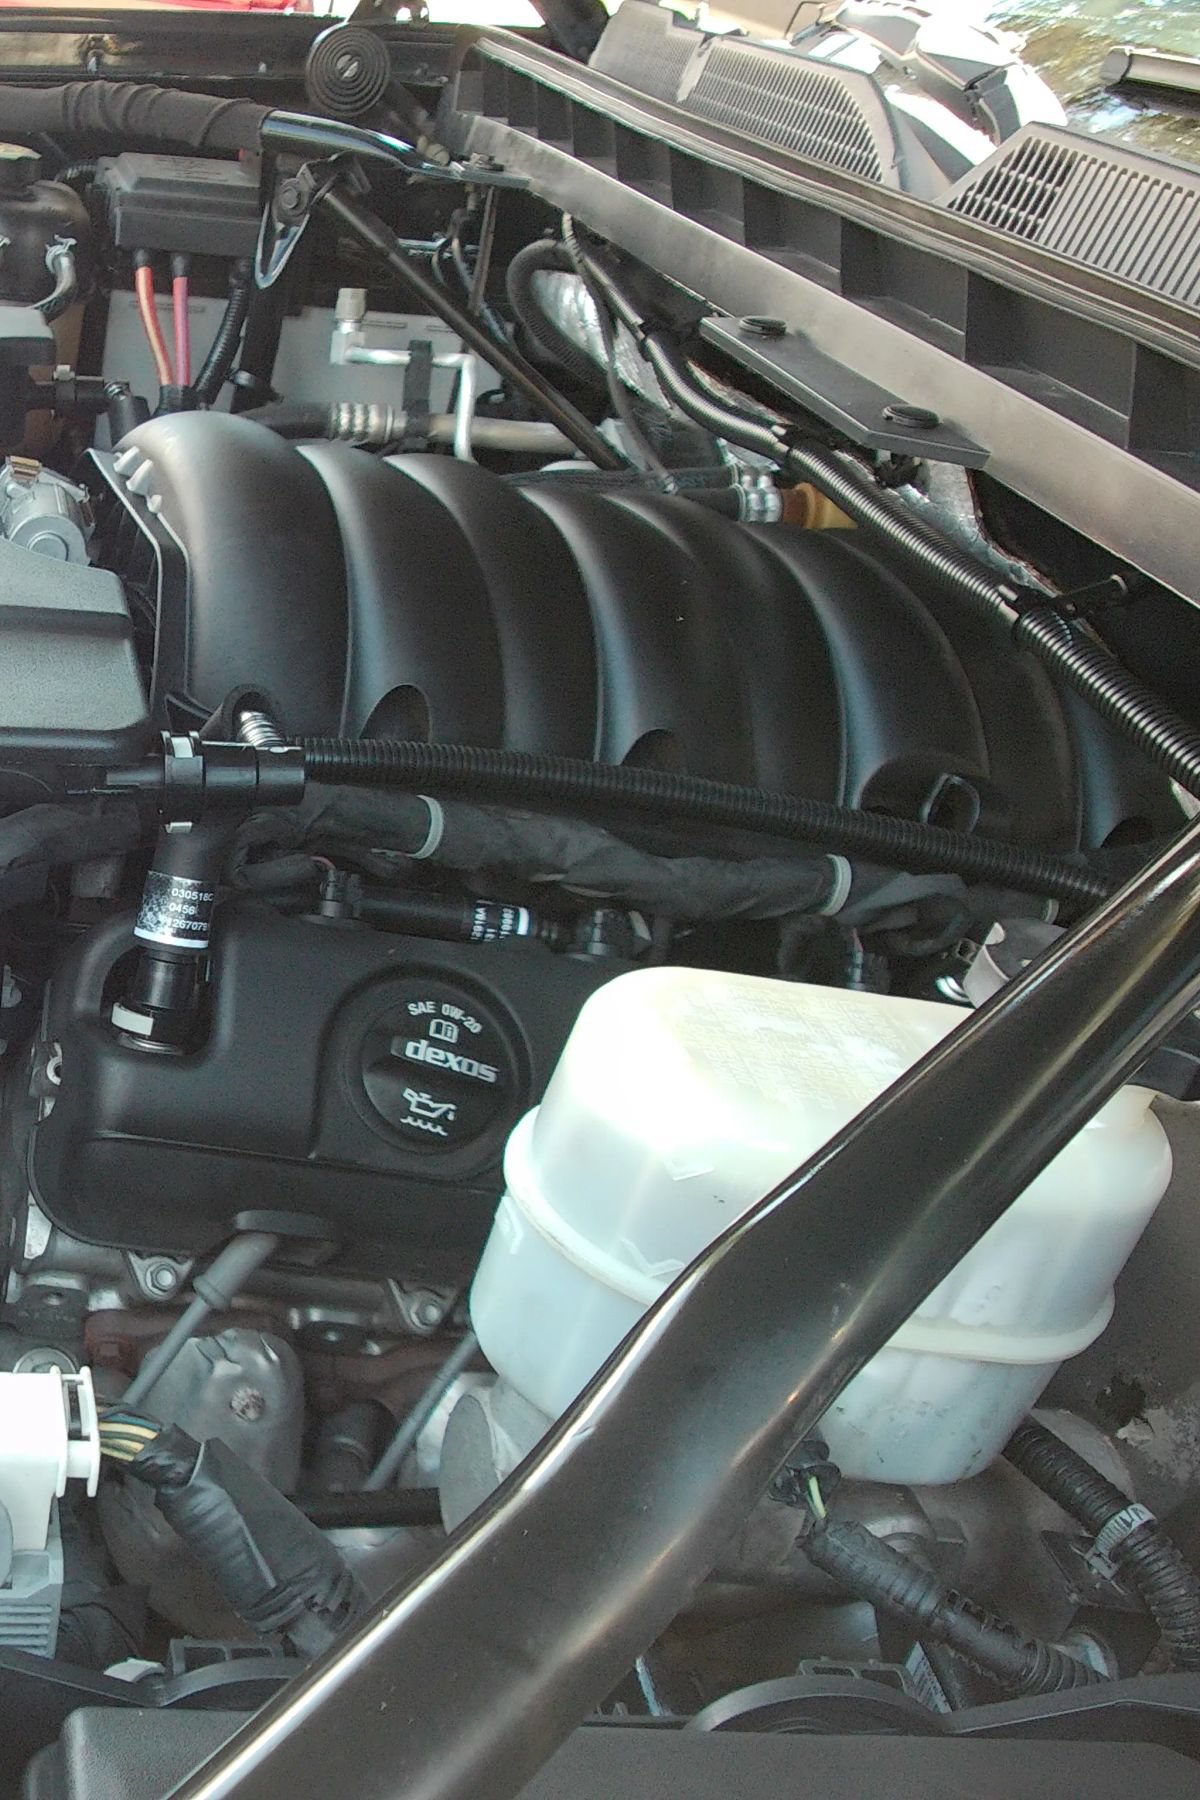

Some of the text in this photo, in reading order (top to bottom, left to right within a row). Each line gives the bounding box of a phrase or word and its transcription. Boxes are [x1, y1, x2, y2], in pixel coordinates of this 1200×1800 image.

[407, 1001, 483, 1034] SAE 0W-20
[405, 1039, 501, 1083] dexos
